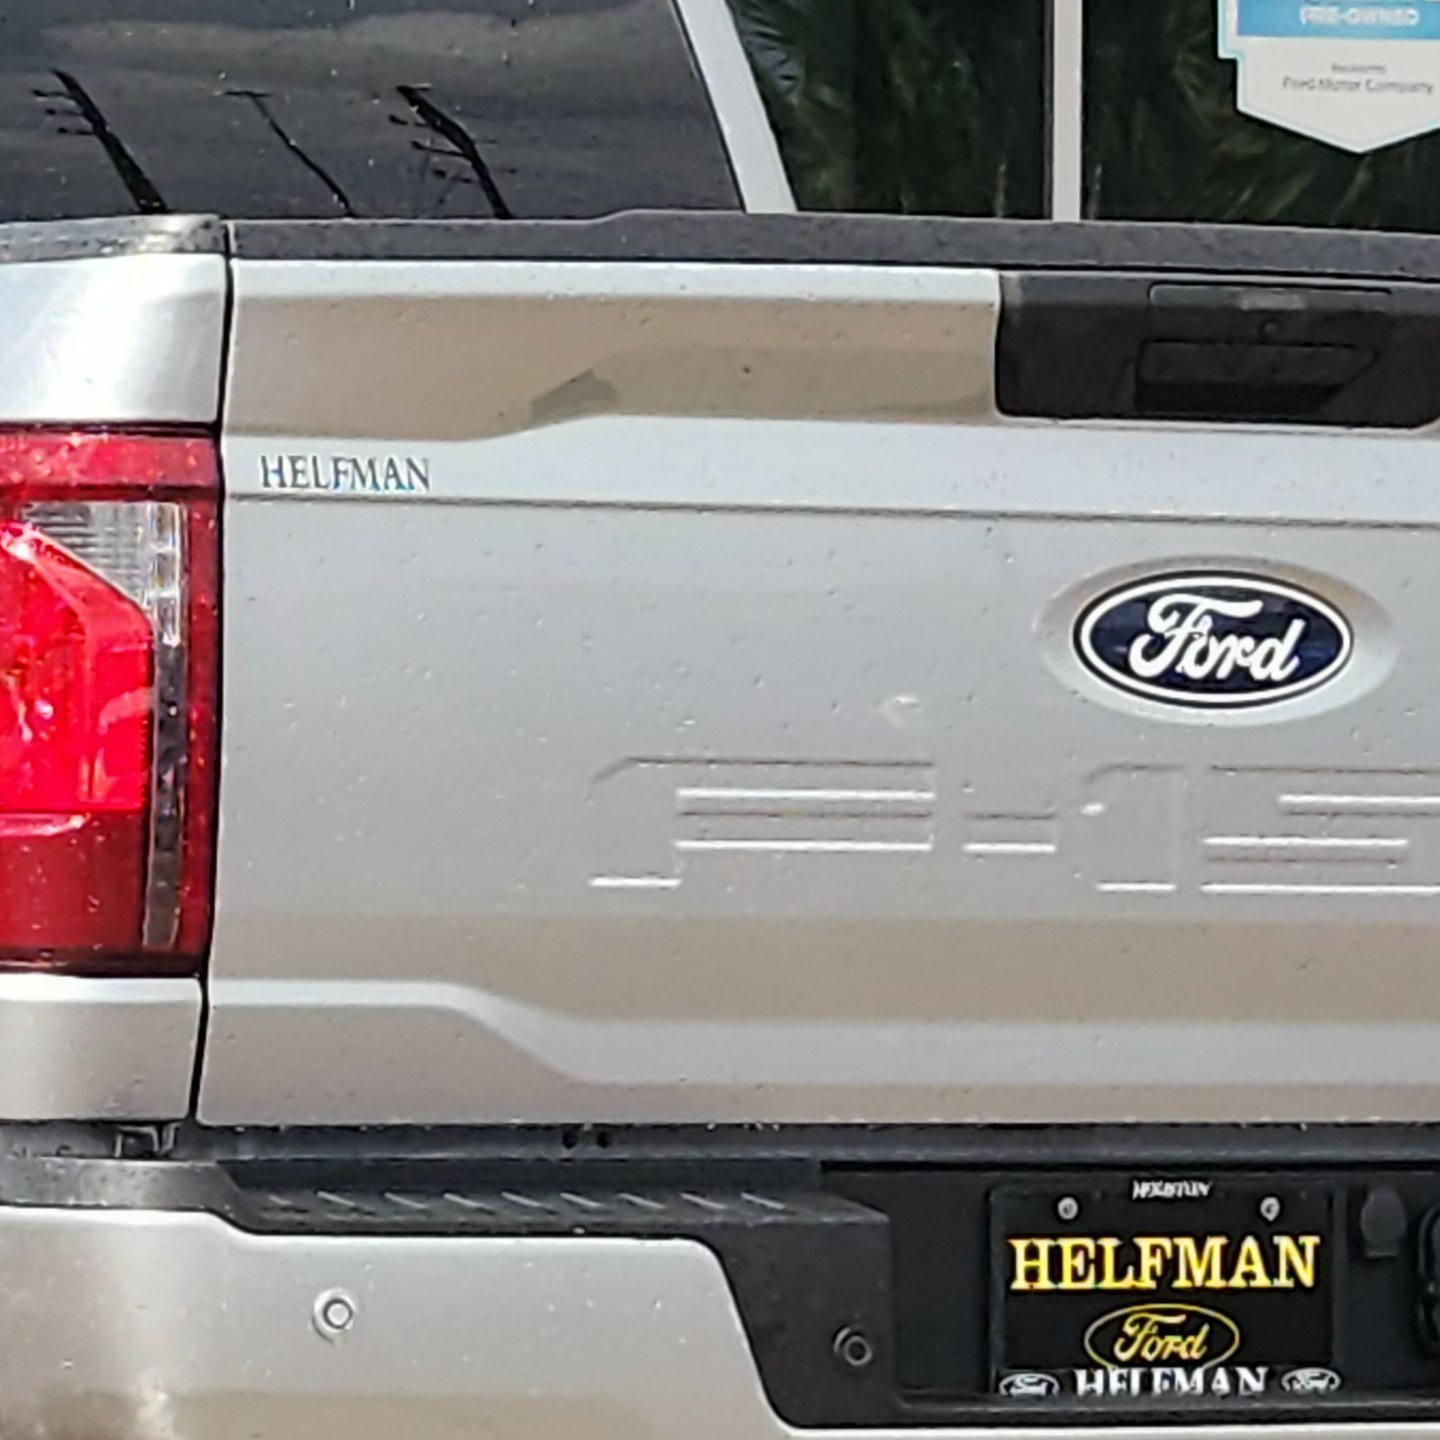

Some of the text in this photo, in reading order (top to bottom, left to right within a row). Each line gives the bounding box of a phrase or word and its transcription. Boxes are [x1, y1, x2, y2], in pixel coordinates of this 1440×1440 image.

[261, 454, 432, 491] HELFMAN
[1129, 592, 1307, 681] Ford
[1008, 1235, 1320, 1290] HELFMAN
[1114, 1312, 1210, 1361] Ford
